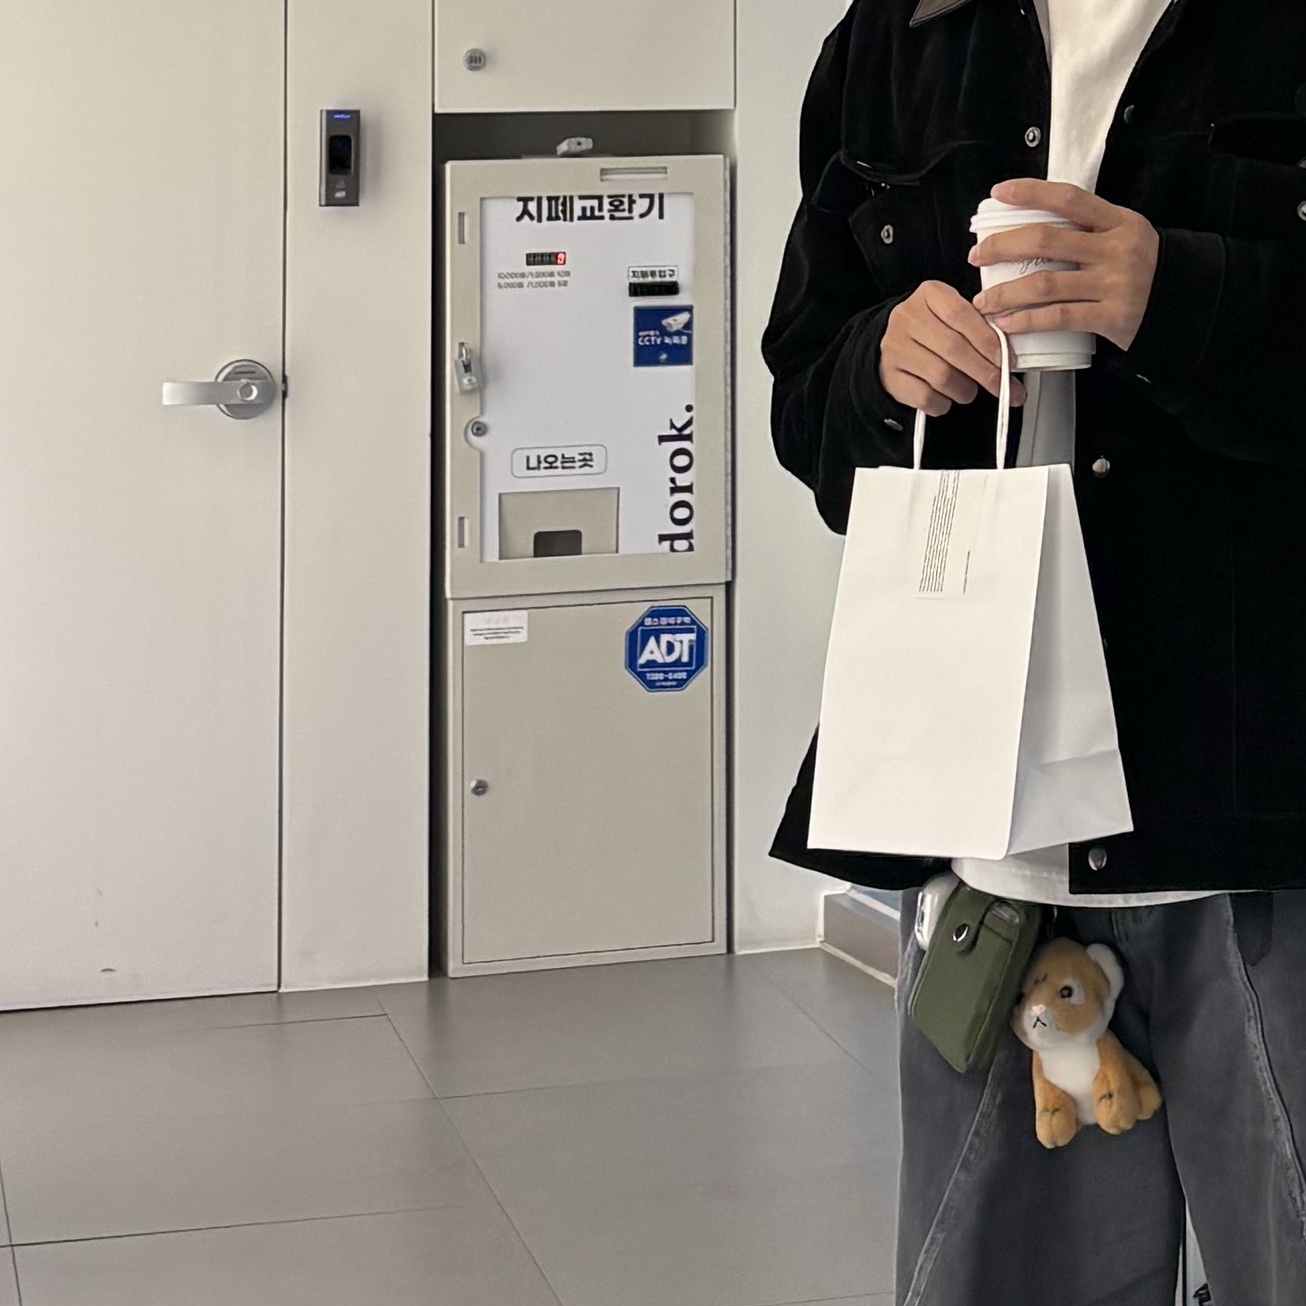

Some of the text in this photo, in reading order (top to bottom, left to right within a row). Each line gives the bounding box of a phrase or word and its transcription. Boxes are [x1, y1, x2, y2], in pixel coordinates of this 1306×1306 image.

[515, 193, 665, 224] 지폐교환기
[638, 336, 662, 345] CCTV
[525, 451, 595, 471] 나오는곳
[657, 403, 695, 553] dorok.
[637, 633, 697, 665] ADT
